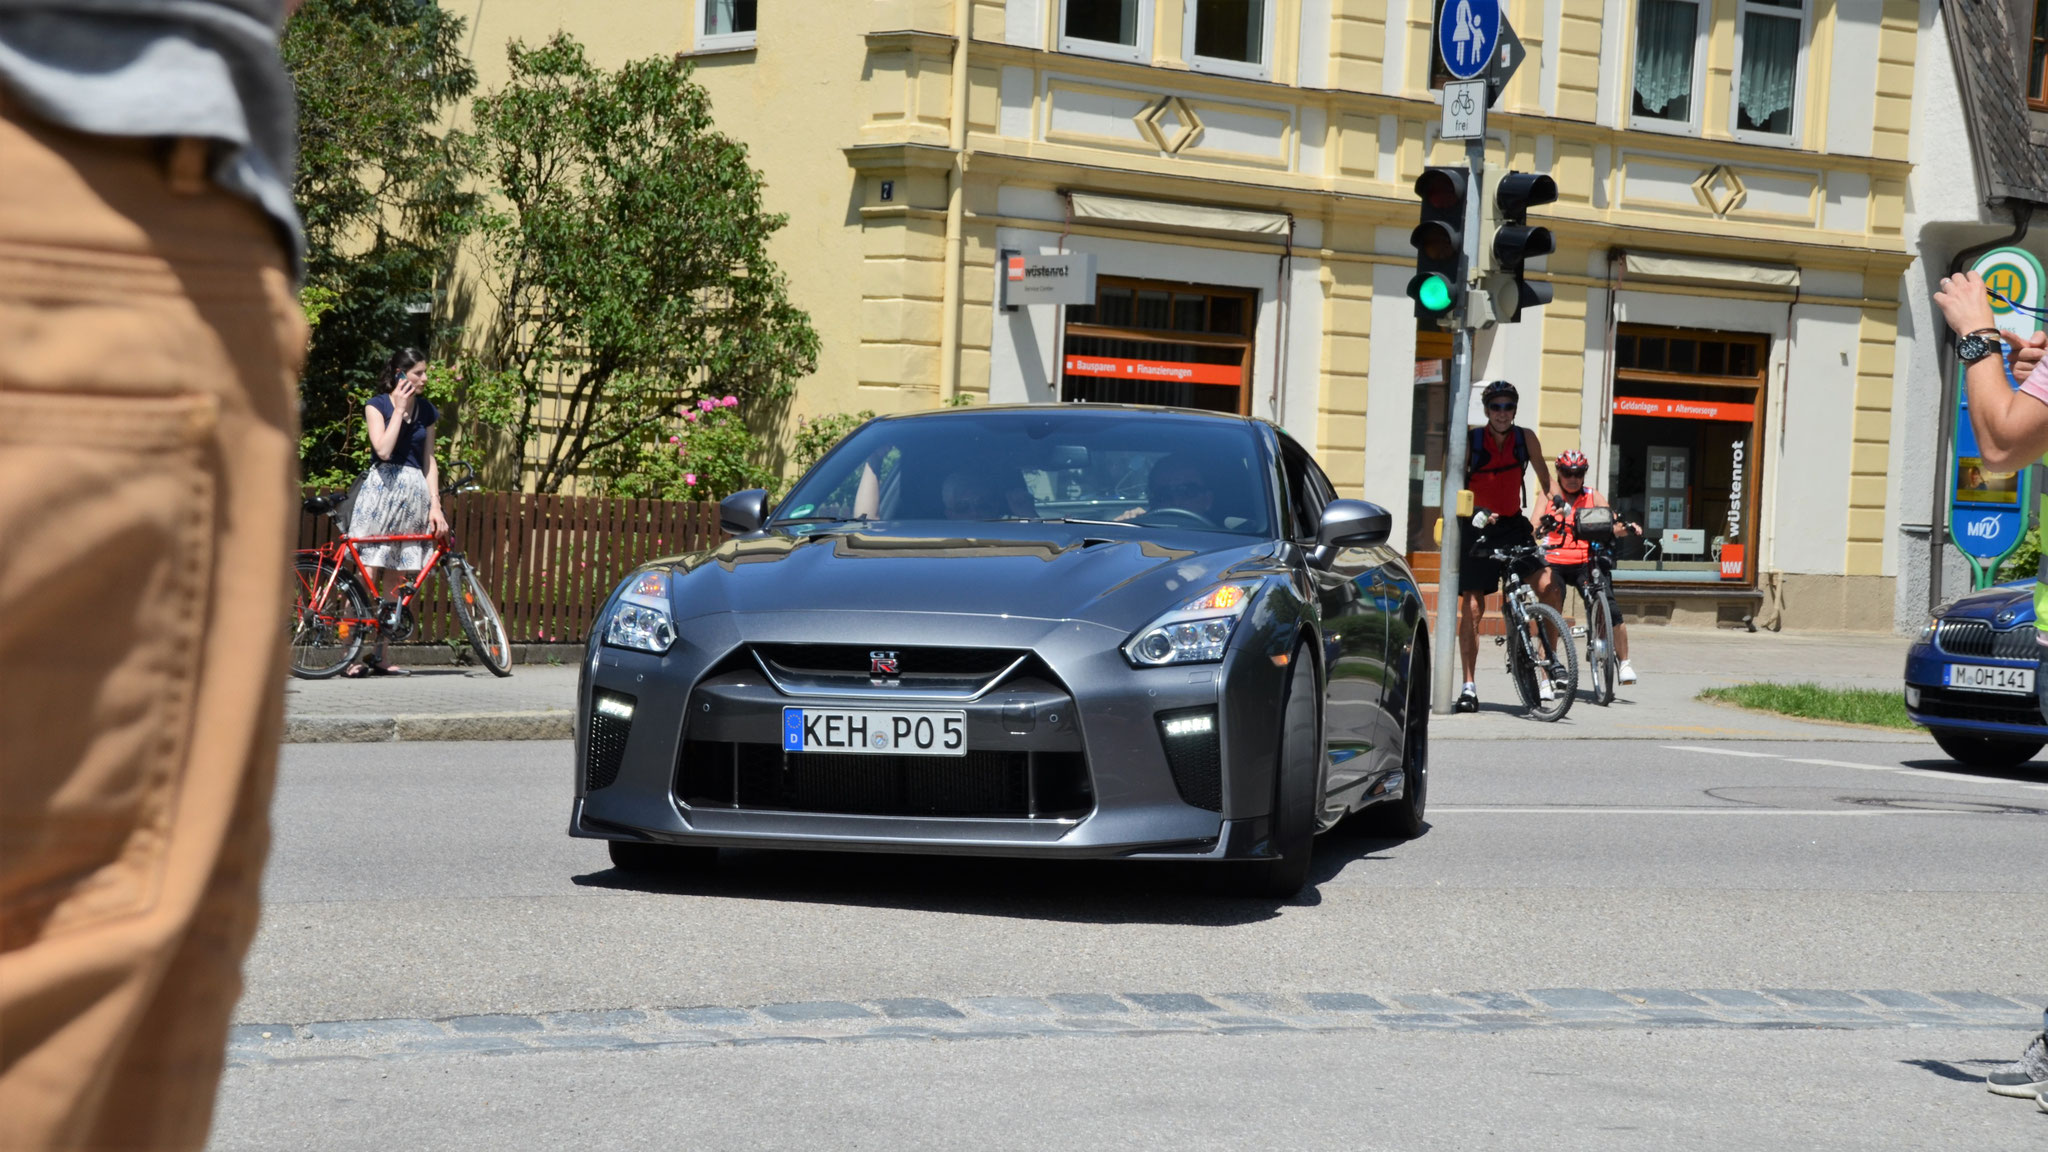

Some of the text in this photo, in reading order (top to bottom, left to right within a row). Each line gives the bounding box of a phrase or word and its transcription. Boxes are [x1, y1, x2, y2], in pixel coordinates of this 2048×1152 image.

[1455, 119, 1469, 131] frei
[1025, 264, 1069, 277] wüstenrot
[1992, 274, 2013, 303] H
[1077, 360, 1192, 379] Bausparen Finanzierungen
[1620, 401, 1718, 417] Geldanlagen Altersvorsorge
[1727, 440, 1744, 538] wüstenrot
[869, 651, 899, 659] GT
[871, 659, 897, 673] R
[1956, 667, 2026, 689] M OH 141
[789, 733, 799, 744] D
[803, 714, 963, 750] KEH PO 5
